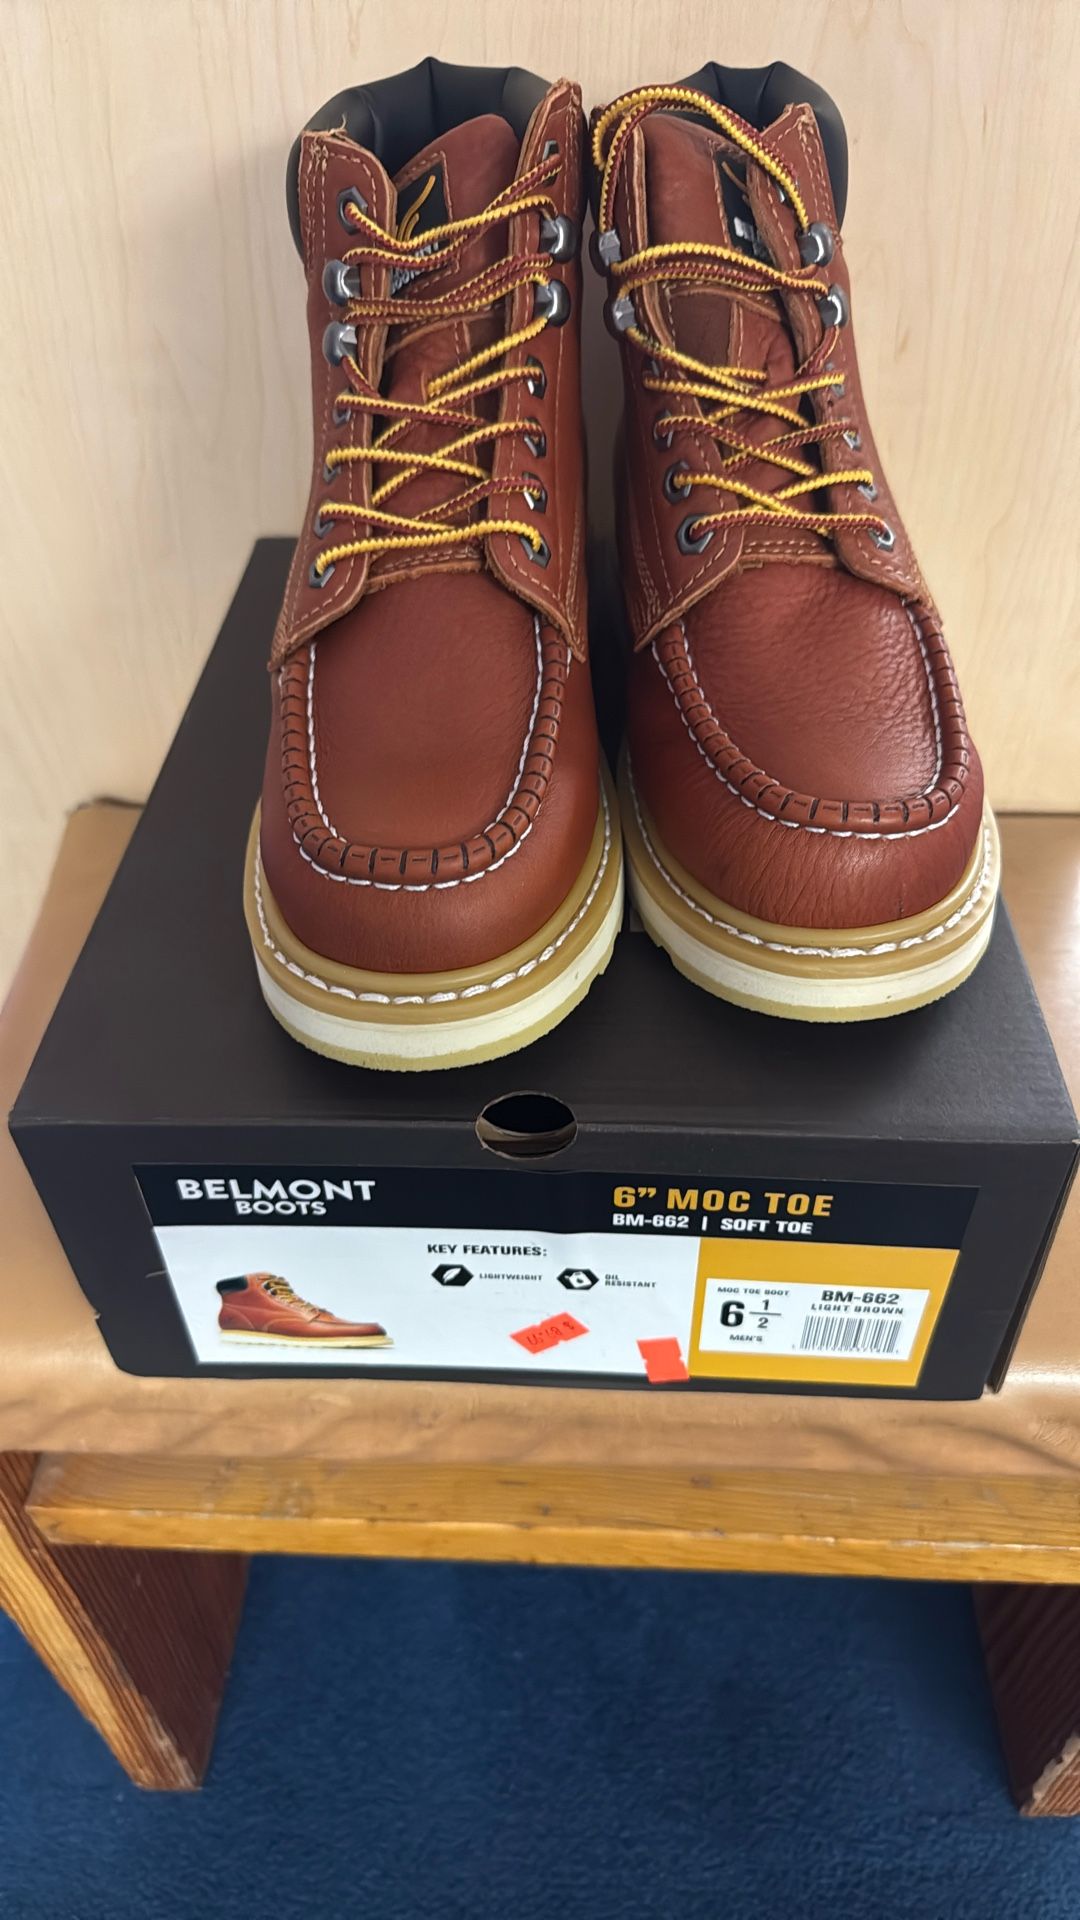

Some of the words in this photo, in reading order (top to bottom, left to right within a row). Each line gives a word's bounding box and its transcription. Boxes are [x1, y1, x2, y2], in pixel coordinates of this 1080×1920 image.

[176, 1178, 376, 1201] BELMONT
[235, 1200, 327, 1216] BOOTS
[667, 1188, 751, 1212] MOC
[764, 1192, 834, 1217] TOE
[612, 1213, 690, 1229] BM-662
[720, 1217, 770, 1233] SOFT
[776, 1220, 814, 1235] TOE
[427, 1243, 458, 1254] KEY
[463, 1244, 548, 1257] FEATURES:
[479, 1272, 543, 1281] LIGHTWEIGHT
[604, 1280, 657, 1288] RESISTANT
[717, 1286, 740, 1294] MOC
[743, 1287, 761, 1295] TOE
[821, 1289, 900, 1305] BM-662
[719, 1299, 745, 1328] 6
[811, 1303, 850, 1312] LIGHT
[854, 1305, 904, 1315] BROWN
[729, 1333, 763, 1342] MEN'S
